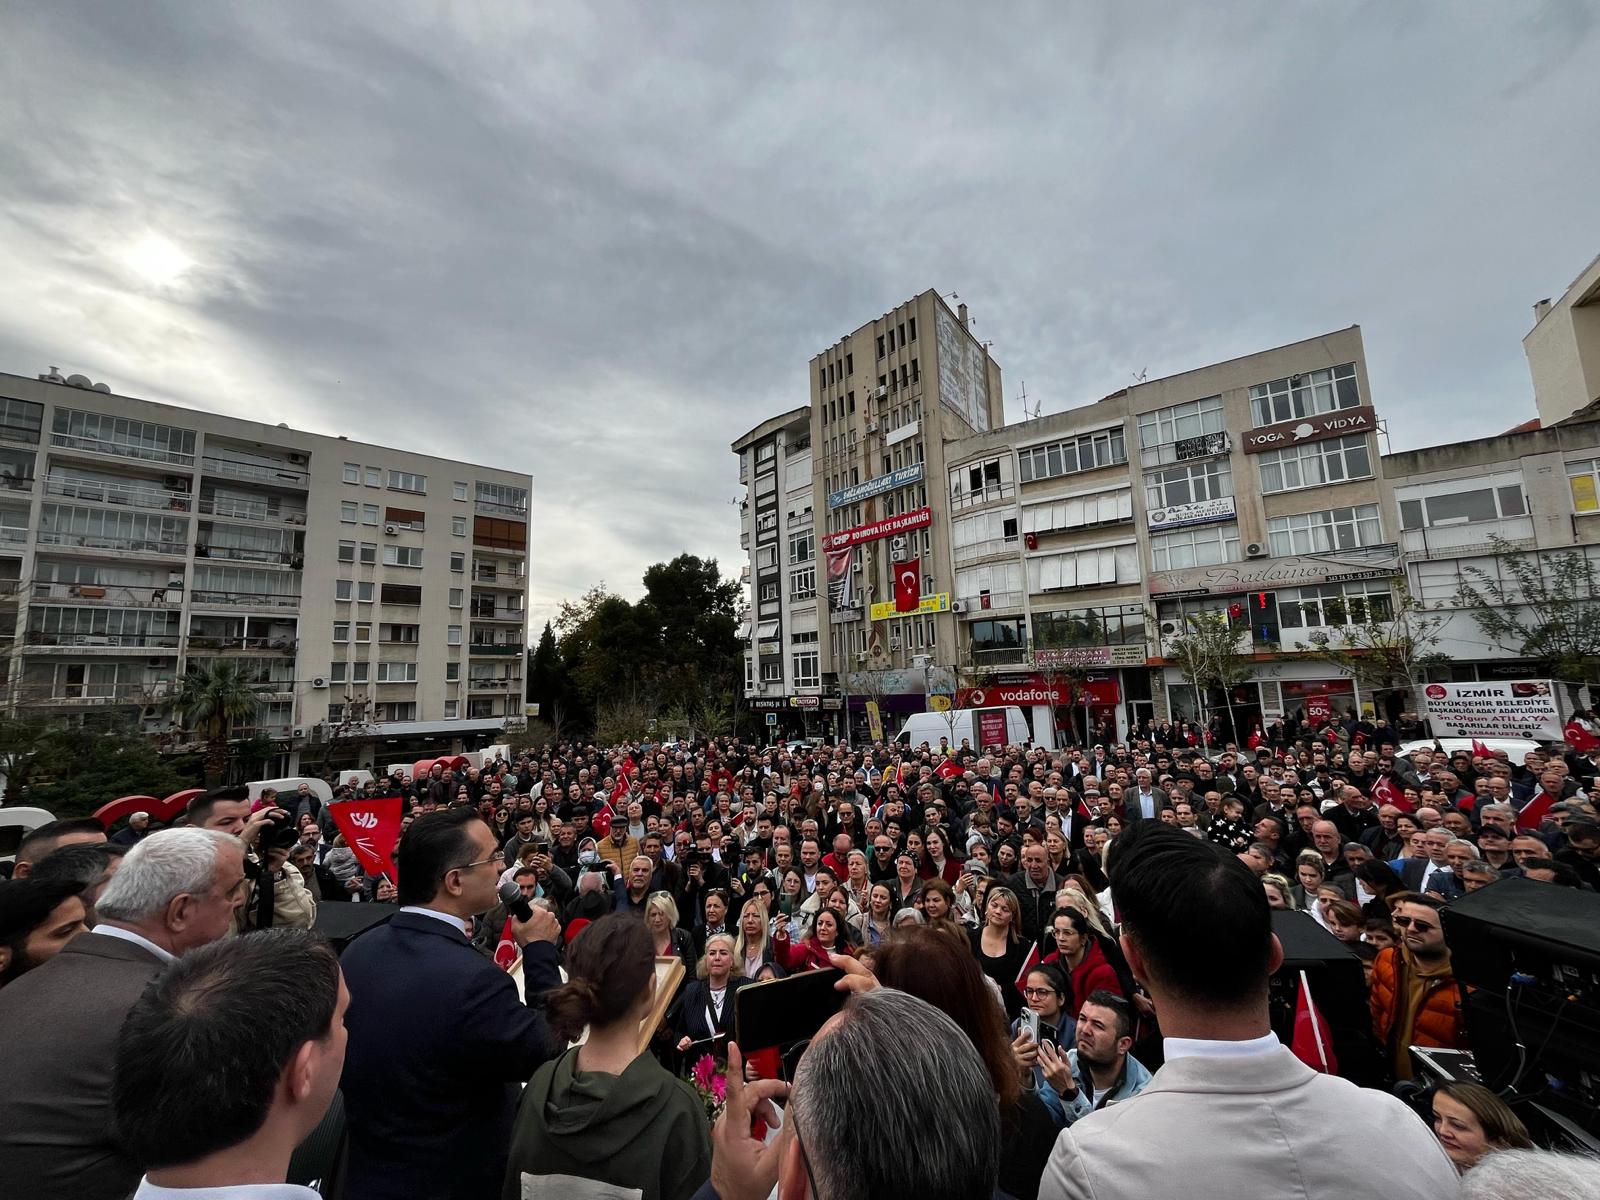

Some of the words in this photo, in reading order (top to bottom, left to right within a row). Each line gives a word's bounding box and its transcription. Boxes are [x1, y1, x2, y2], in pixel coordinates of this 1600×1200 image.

[1250, 432, 1285, 445] YOGA
[833, 534, 850, 546] CHP
[1000, 688, 1060, 701] vodafone
[1456, 688, 1505, 697] İZMİR
[1427, 699, 1493, 707] BÜYÜKŞEHİR
[1495, 698, 1550, 706] BELEDİYE
[1309, 707, 1330, 716] 50%
